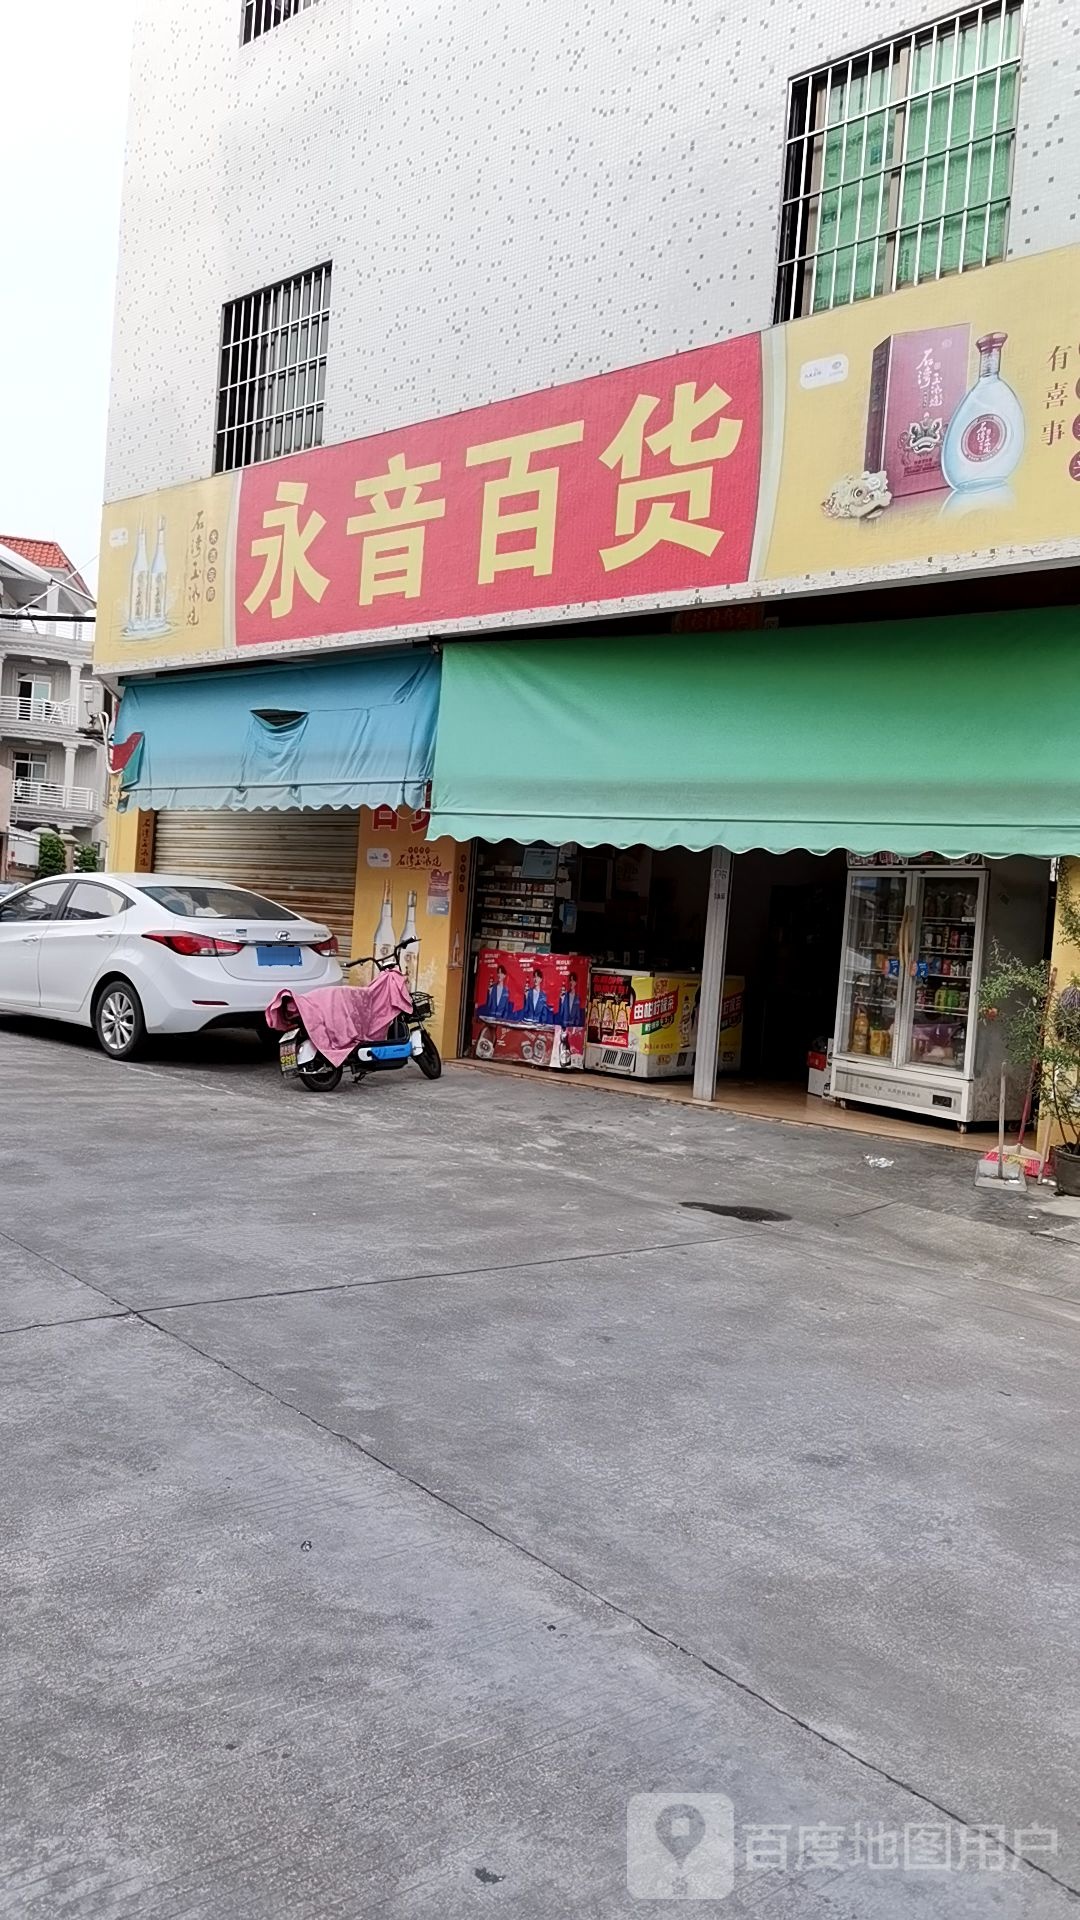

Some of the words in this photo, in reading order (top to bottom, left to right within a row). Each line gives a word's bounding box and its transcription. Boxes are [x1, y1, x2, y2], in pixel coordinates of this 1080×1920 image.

[1041, 345, 1072, 446] 有喜事
[244, 381, 743, 619] 永音百货
